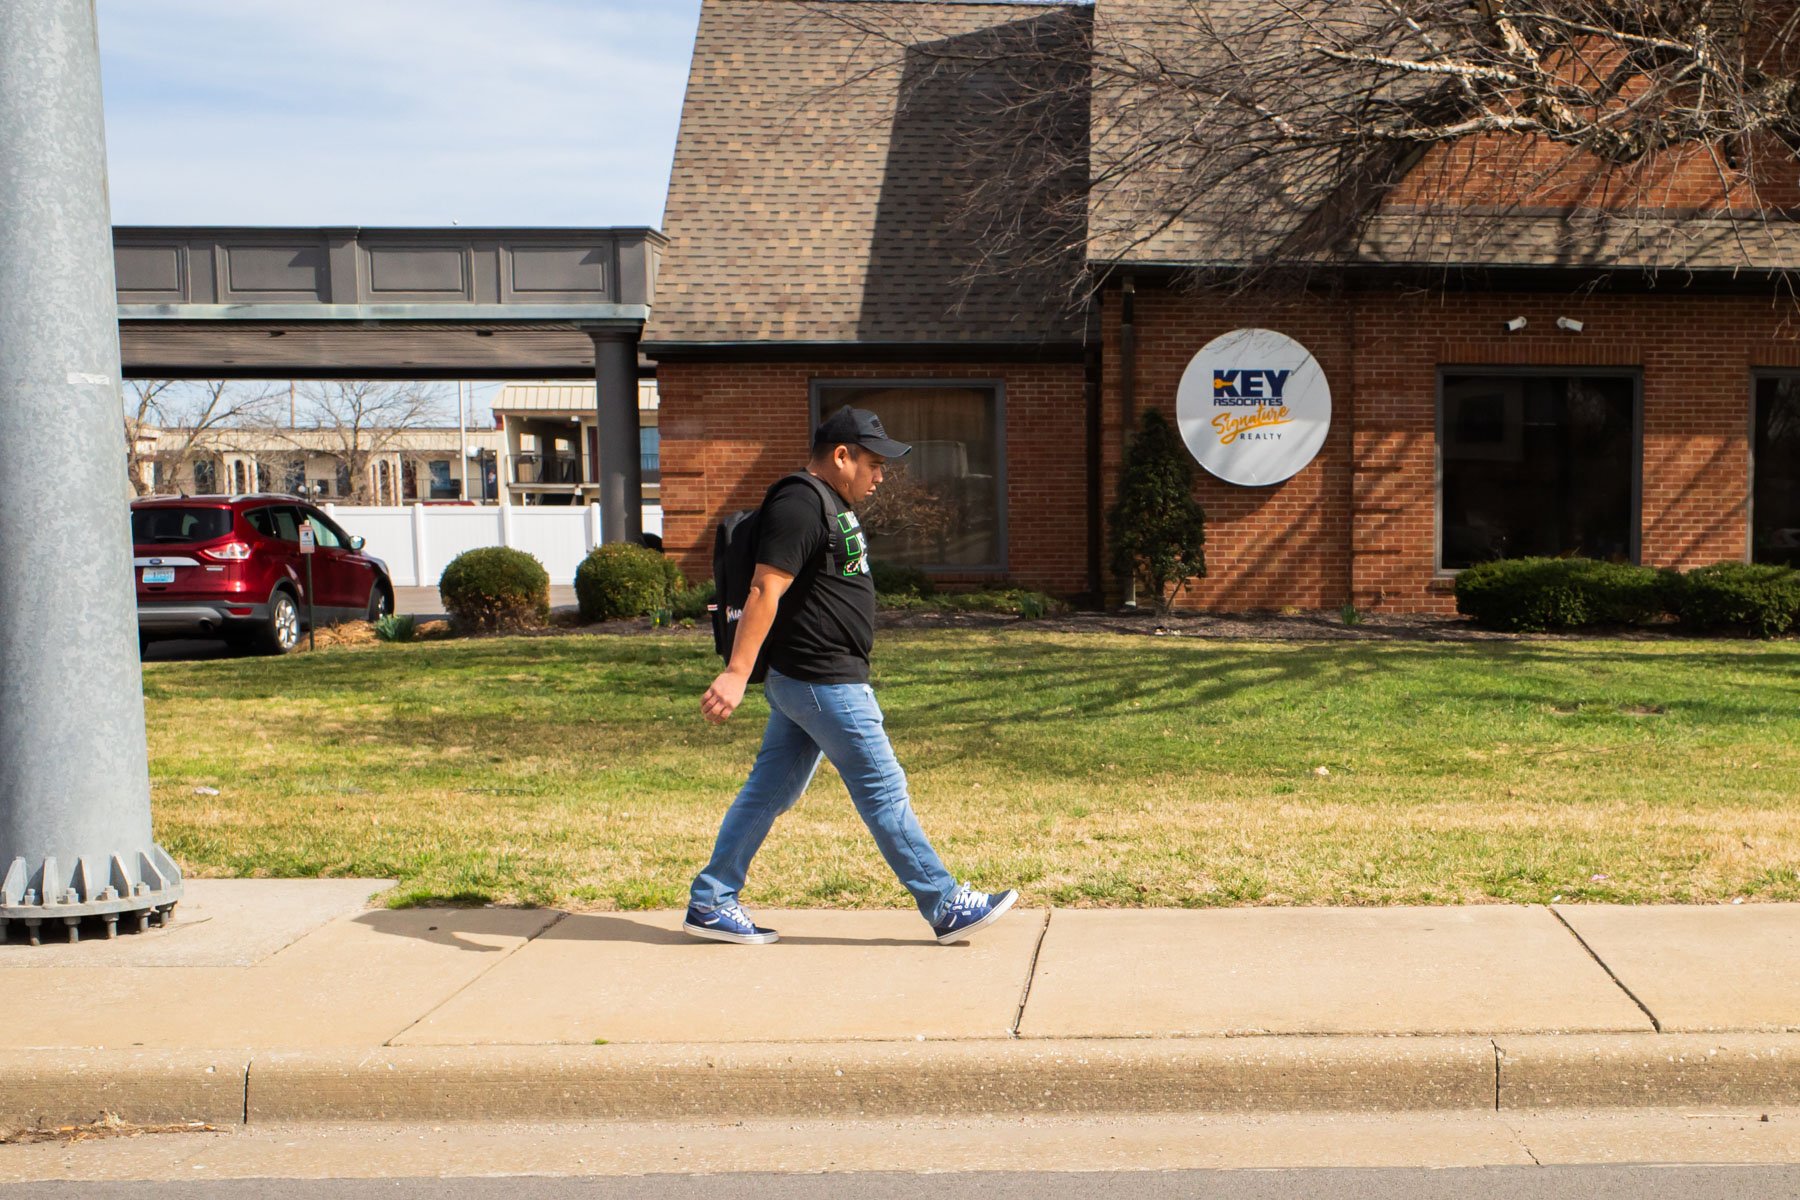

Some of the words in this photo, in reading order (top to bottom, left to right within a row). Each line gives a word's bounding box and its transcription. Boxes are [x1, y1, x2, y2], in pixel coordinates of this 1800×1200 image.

[1213, 369, 1290, 397] KEY
[1213, 398, 1283, 406] ASSOCIATES
[1211, 404, 1294, 445] Signature
